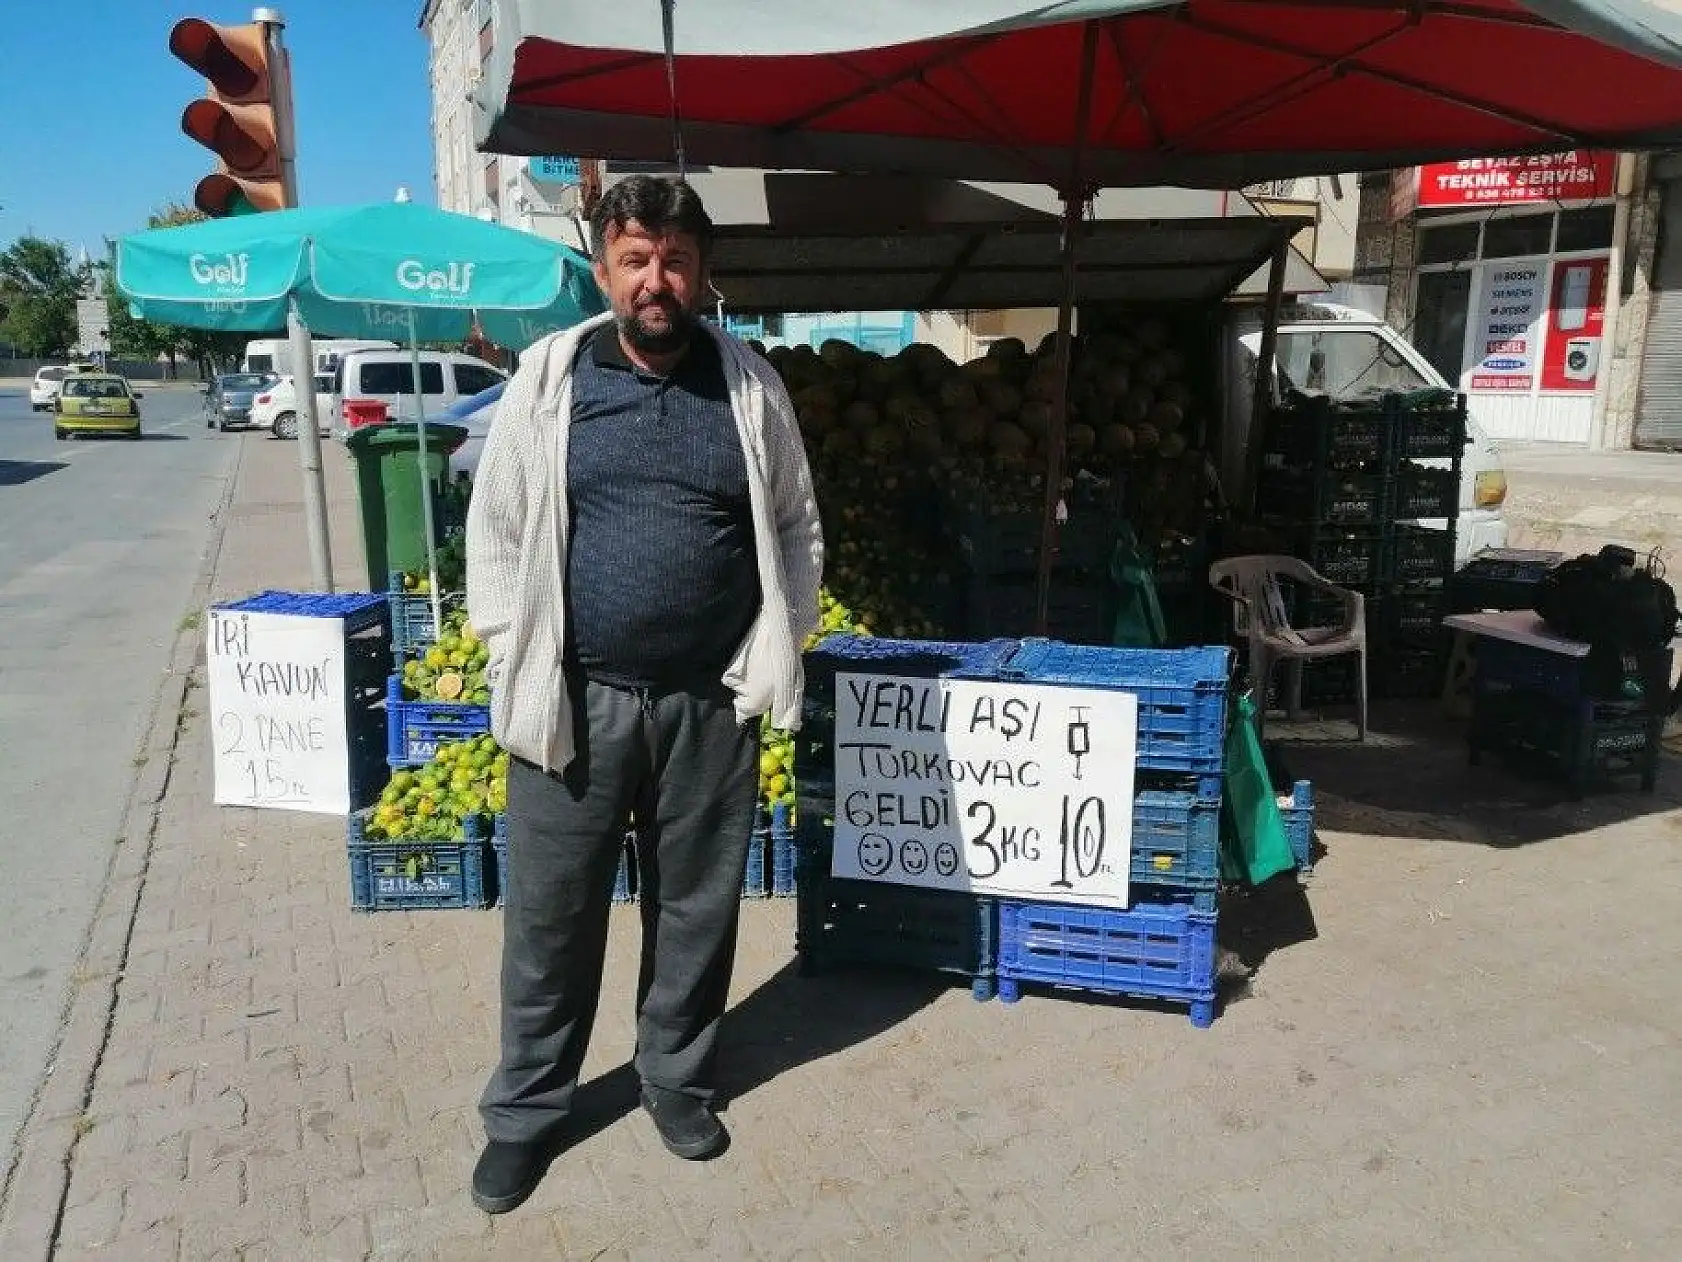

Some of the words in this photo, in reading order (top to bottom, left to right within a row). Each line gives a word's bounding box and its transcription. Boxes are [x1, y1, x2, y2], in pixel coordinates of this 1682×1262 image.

[1437, 169, 1510, 191] TEKNİK
[189, 252, 250, 286] Golf
[396, 260, 474, 293] Golf
[236, 658, 330, 700] KAVUN
[219, 711, 246, 754] 2
[255, 714, 324, 752] TANE
